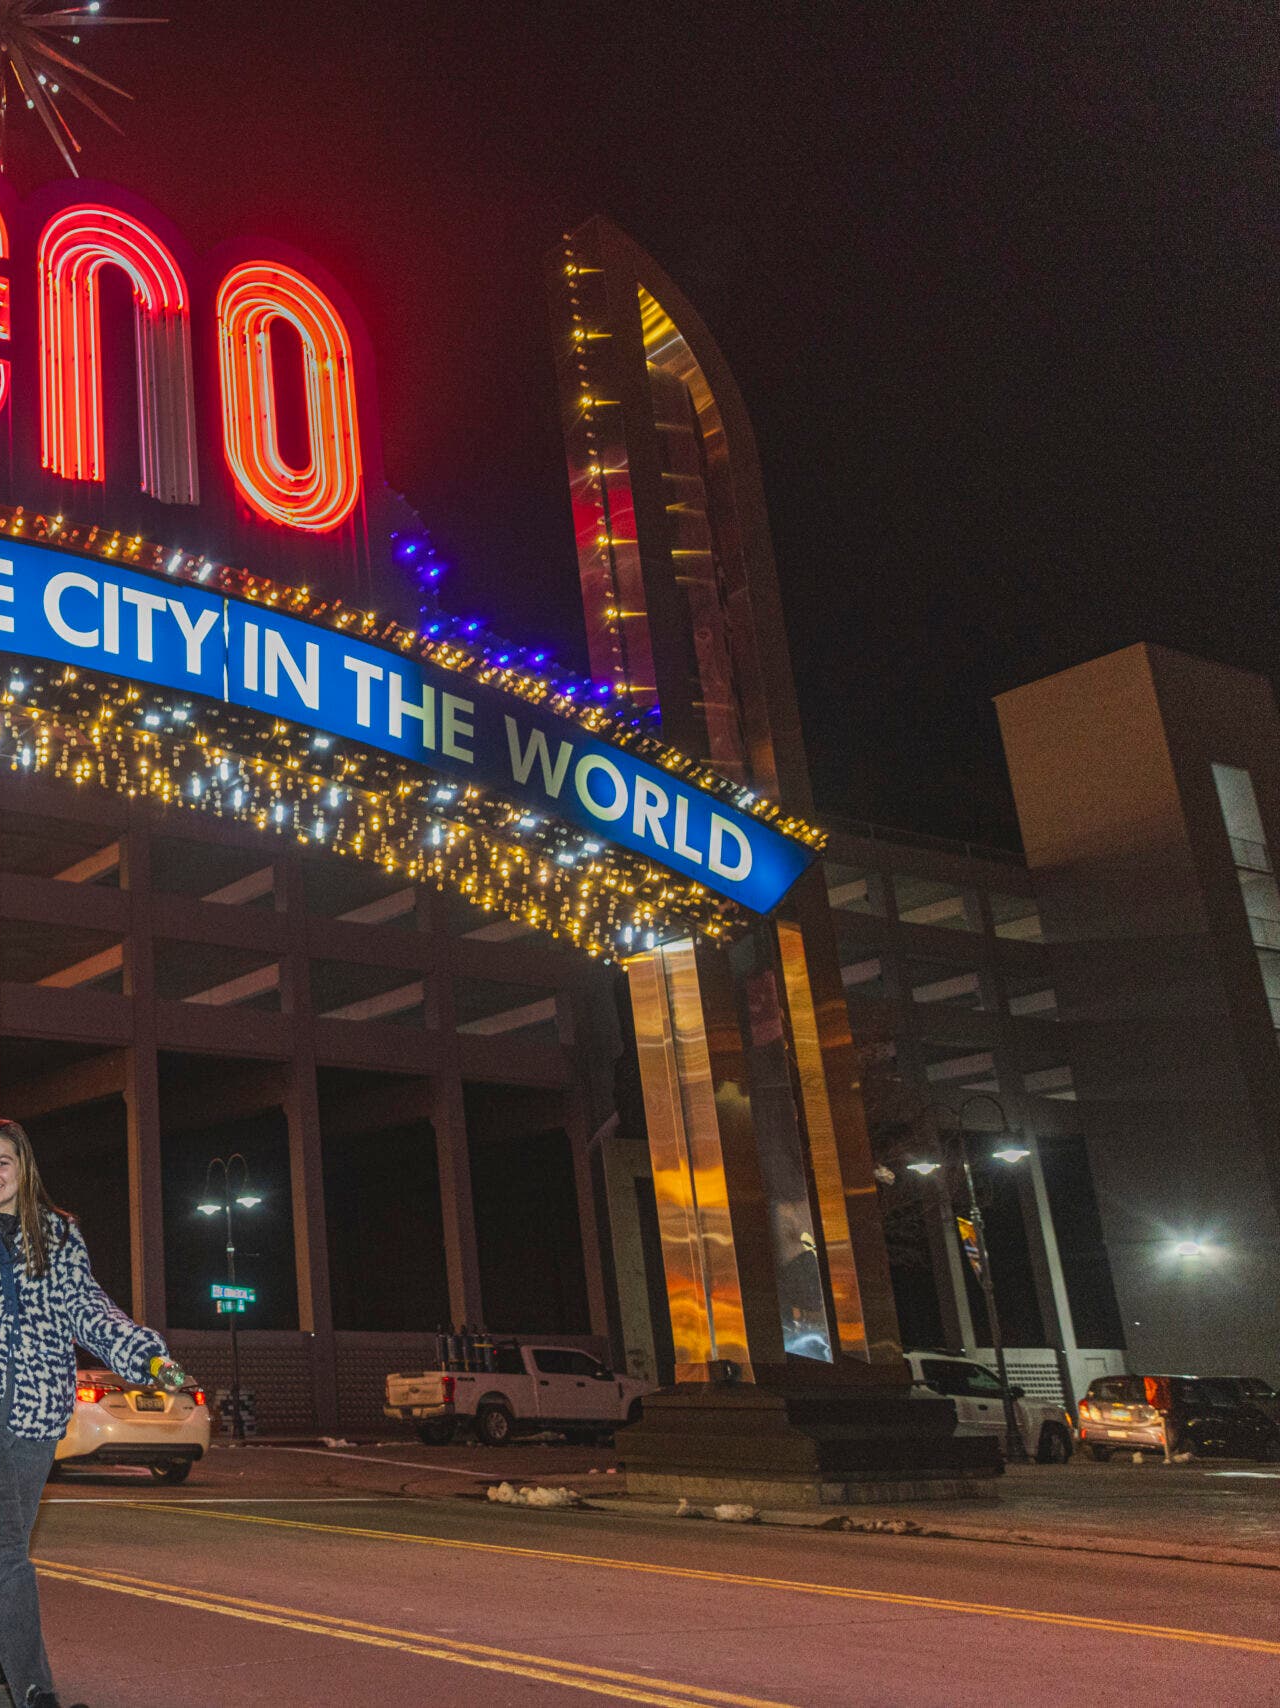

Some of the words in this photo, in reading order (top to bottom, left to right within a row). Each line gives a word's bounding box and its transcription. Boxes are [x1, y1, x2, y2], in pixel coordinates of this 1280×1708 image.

[44, 572, 220, 675] CITY
[244, 622, 320, 711] IN
[344, 655, 475, 764] THE
[504, 714, 753, 882] WORLD
